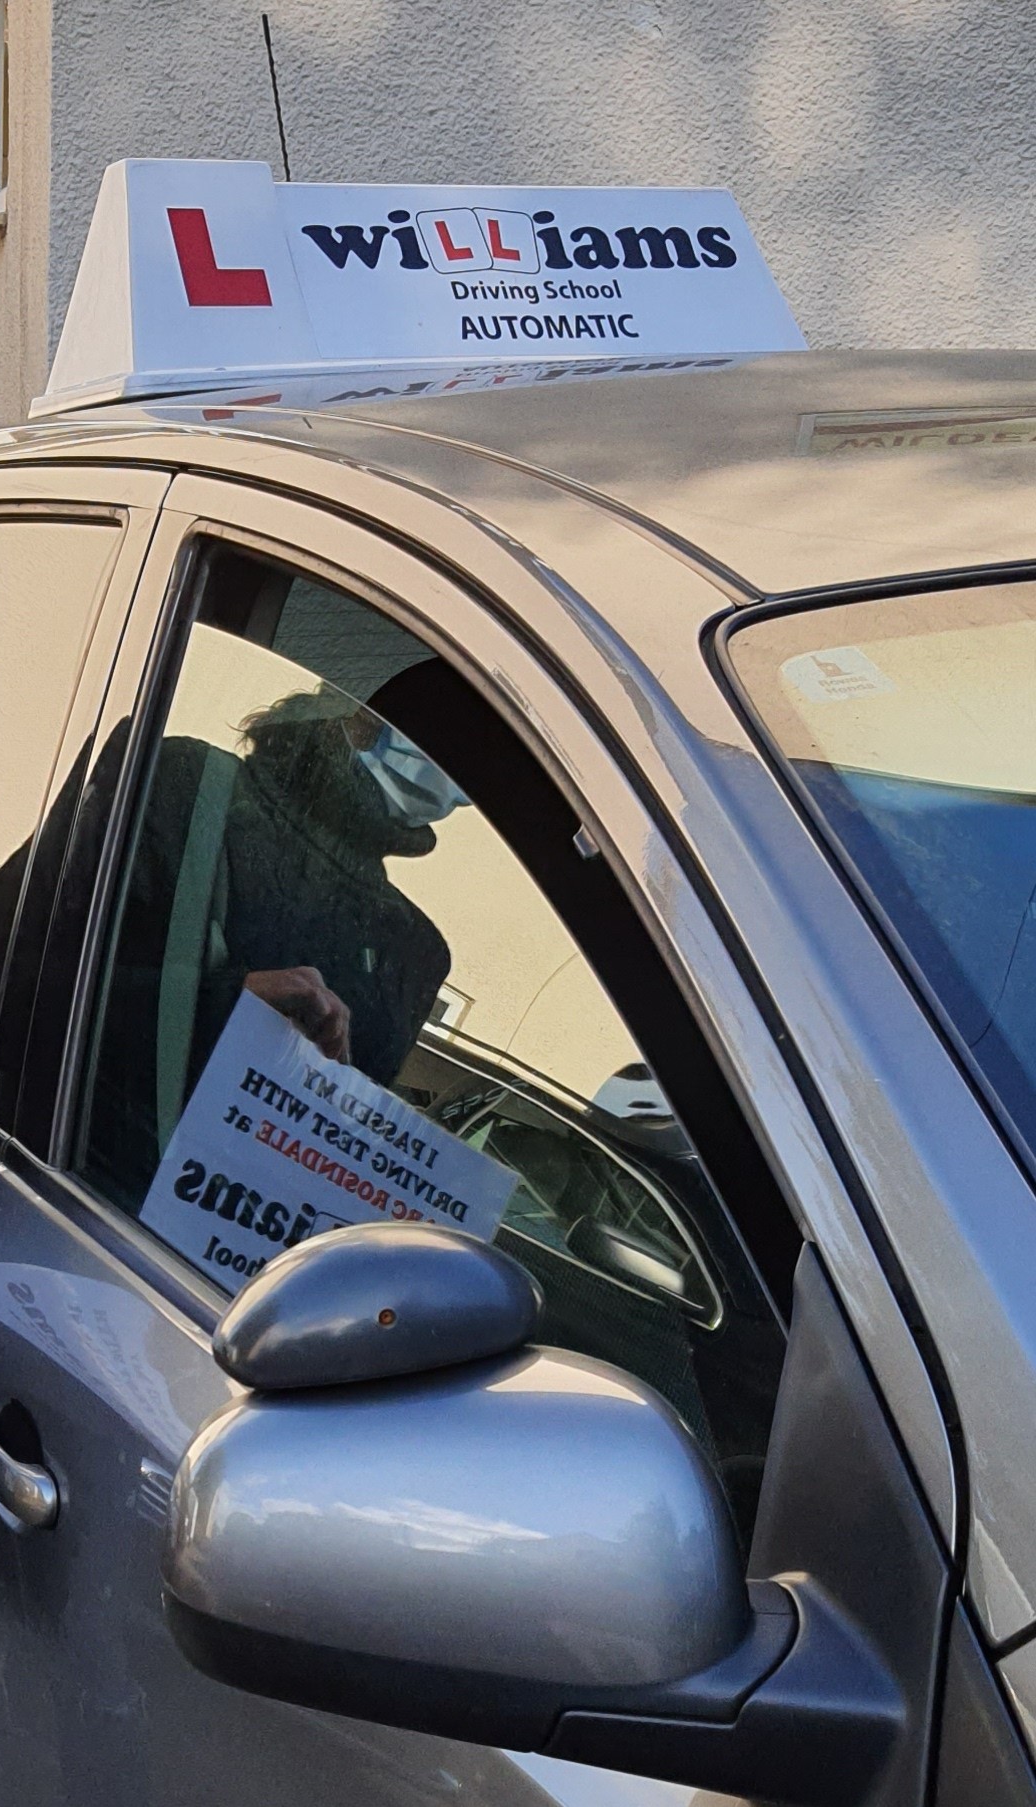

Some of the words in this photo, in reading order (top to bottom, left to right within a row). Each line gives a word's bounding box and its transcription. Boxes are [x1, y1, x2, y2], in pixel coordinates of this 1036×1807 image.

[167, 208, 273, 307] L
[451, 280, 540, 304] Driving
[543, 280, 622, 300] School
[461, 313, 639, 340] AUTOMATIC
